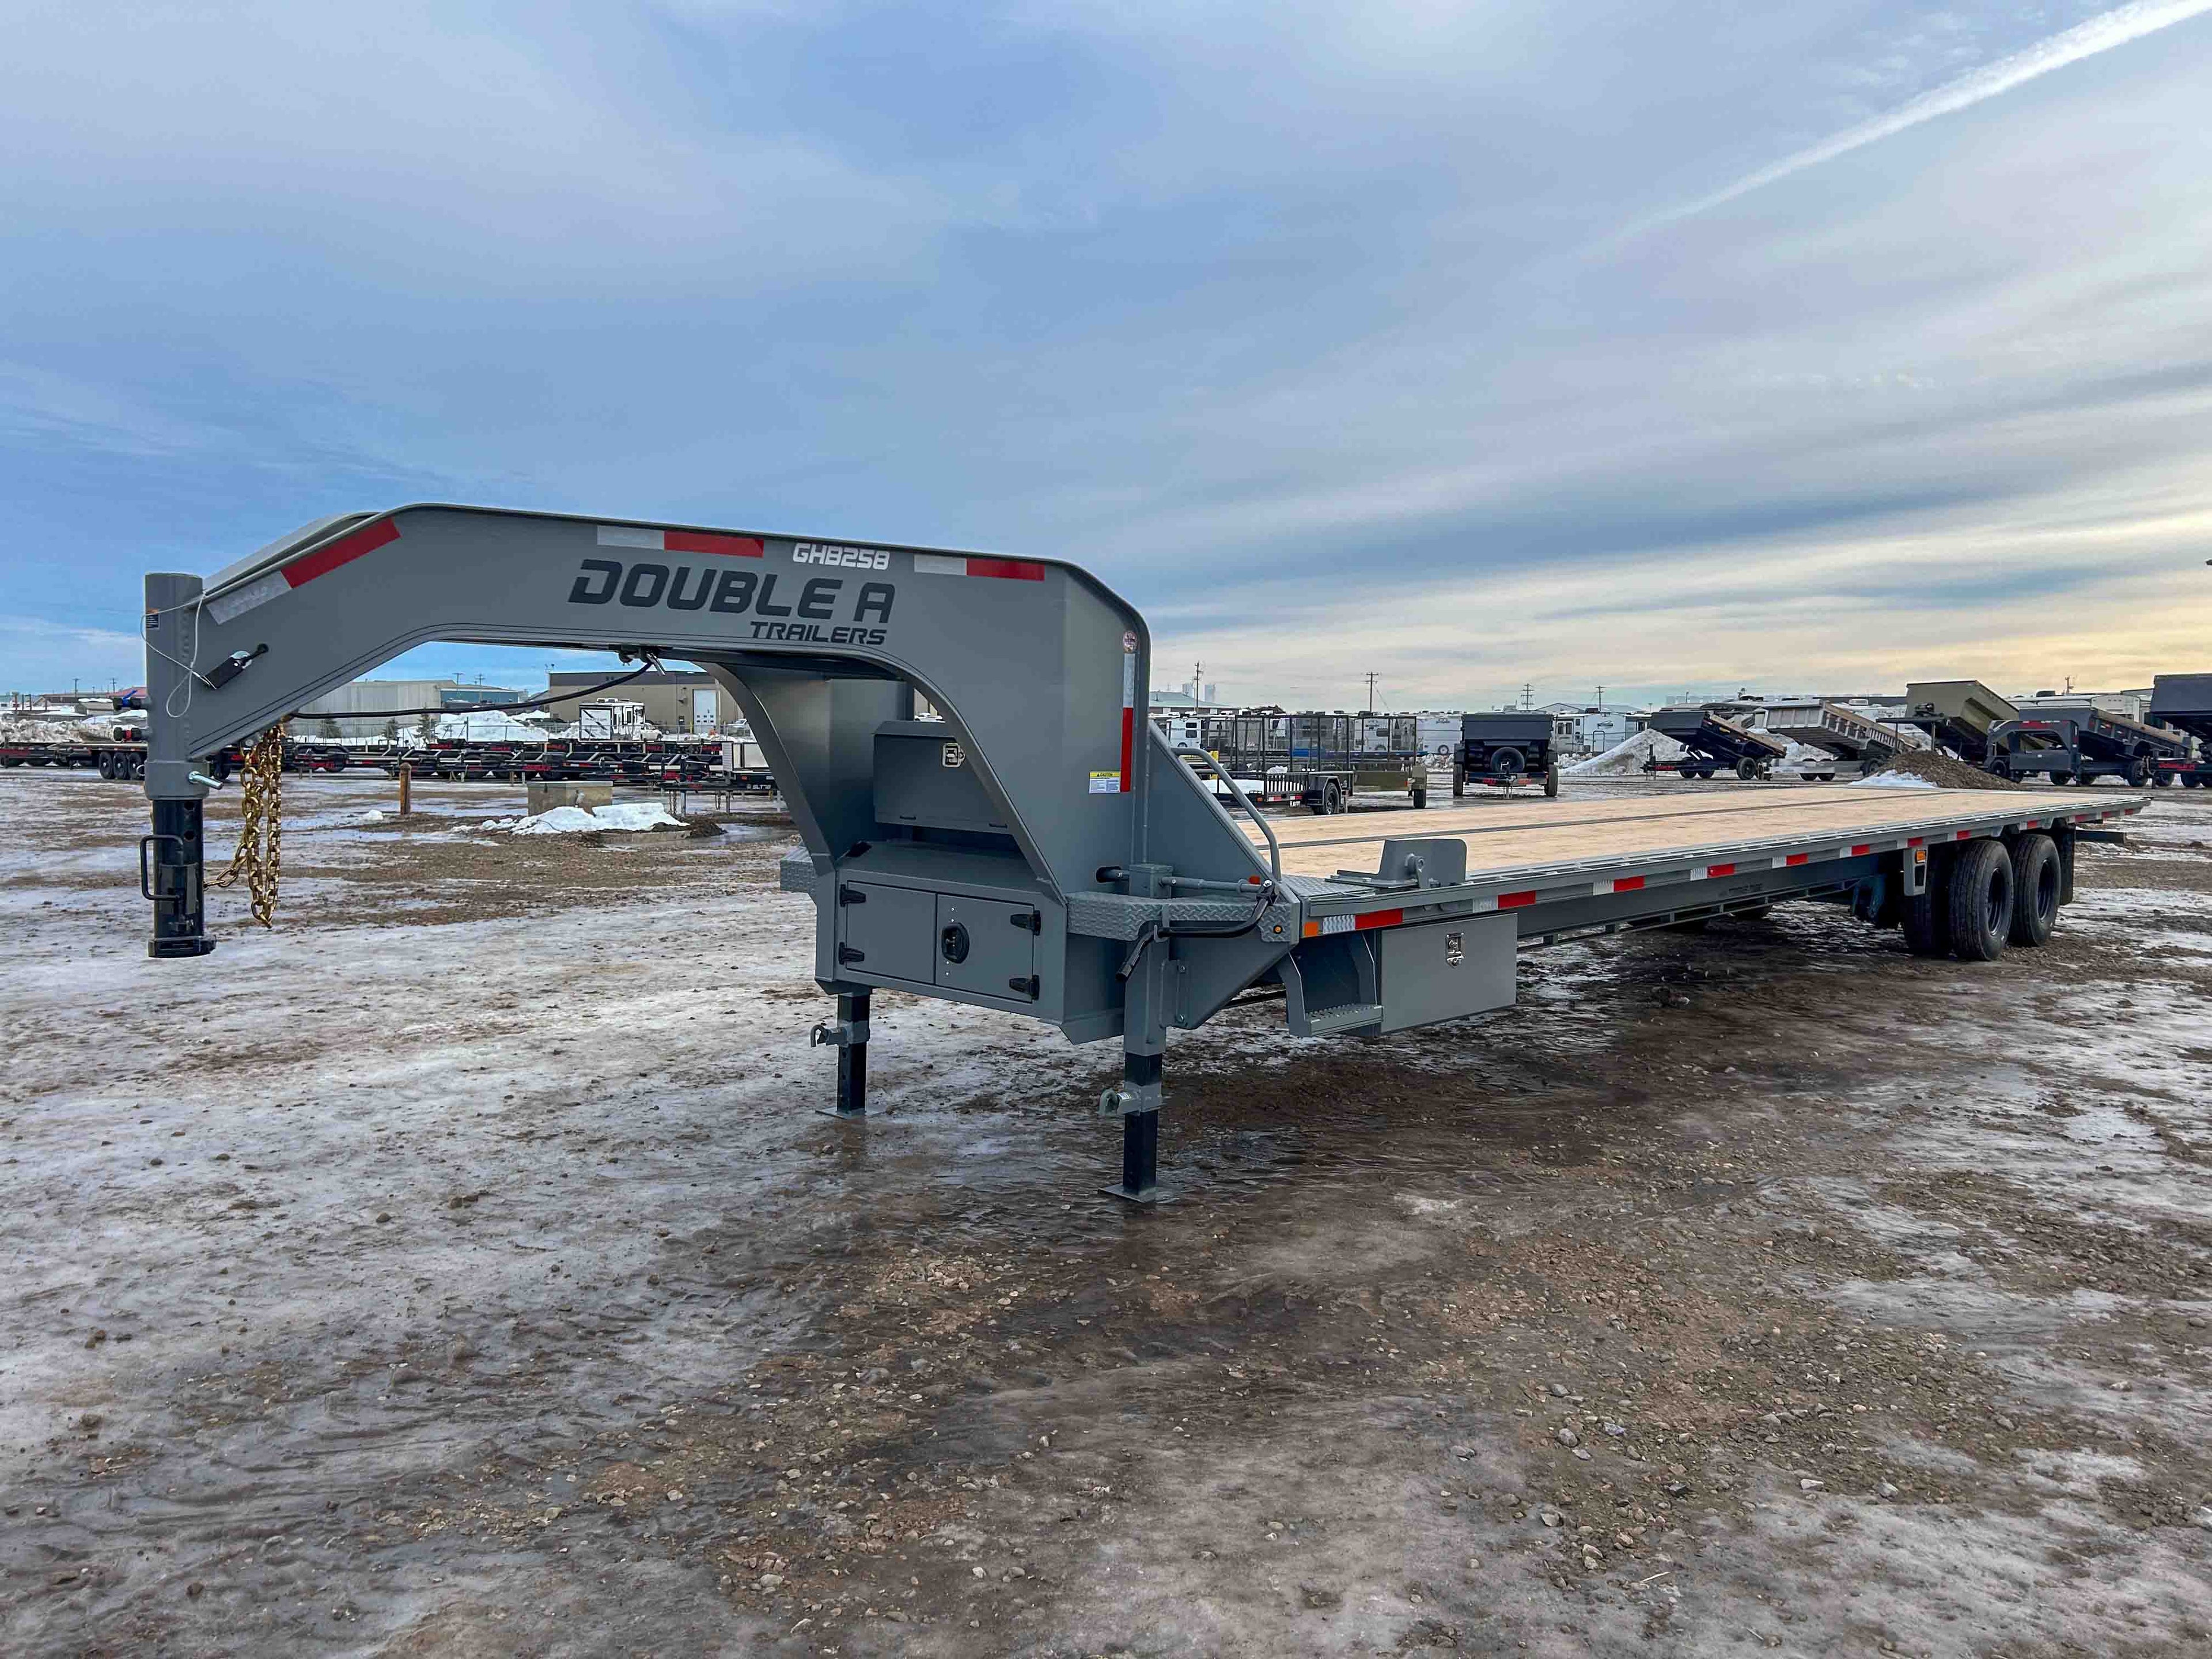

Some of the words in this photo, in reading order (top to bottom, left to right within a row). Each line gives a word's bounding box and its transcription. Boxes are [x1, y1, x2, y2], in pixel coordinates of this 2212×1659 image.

[793, 543, 890, 570] GHB258
[567, 559, 843, 620] DOUBLE
[853, 582, 895, 624] A
[750, 621, 887, 645] TRAILERS
